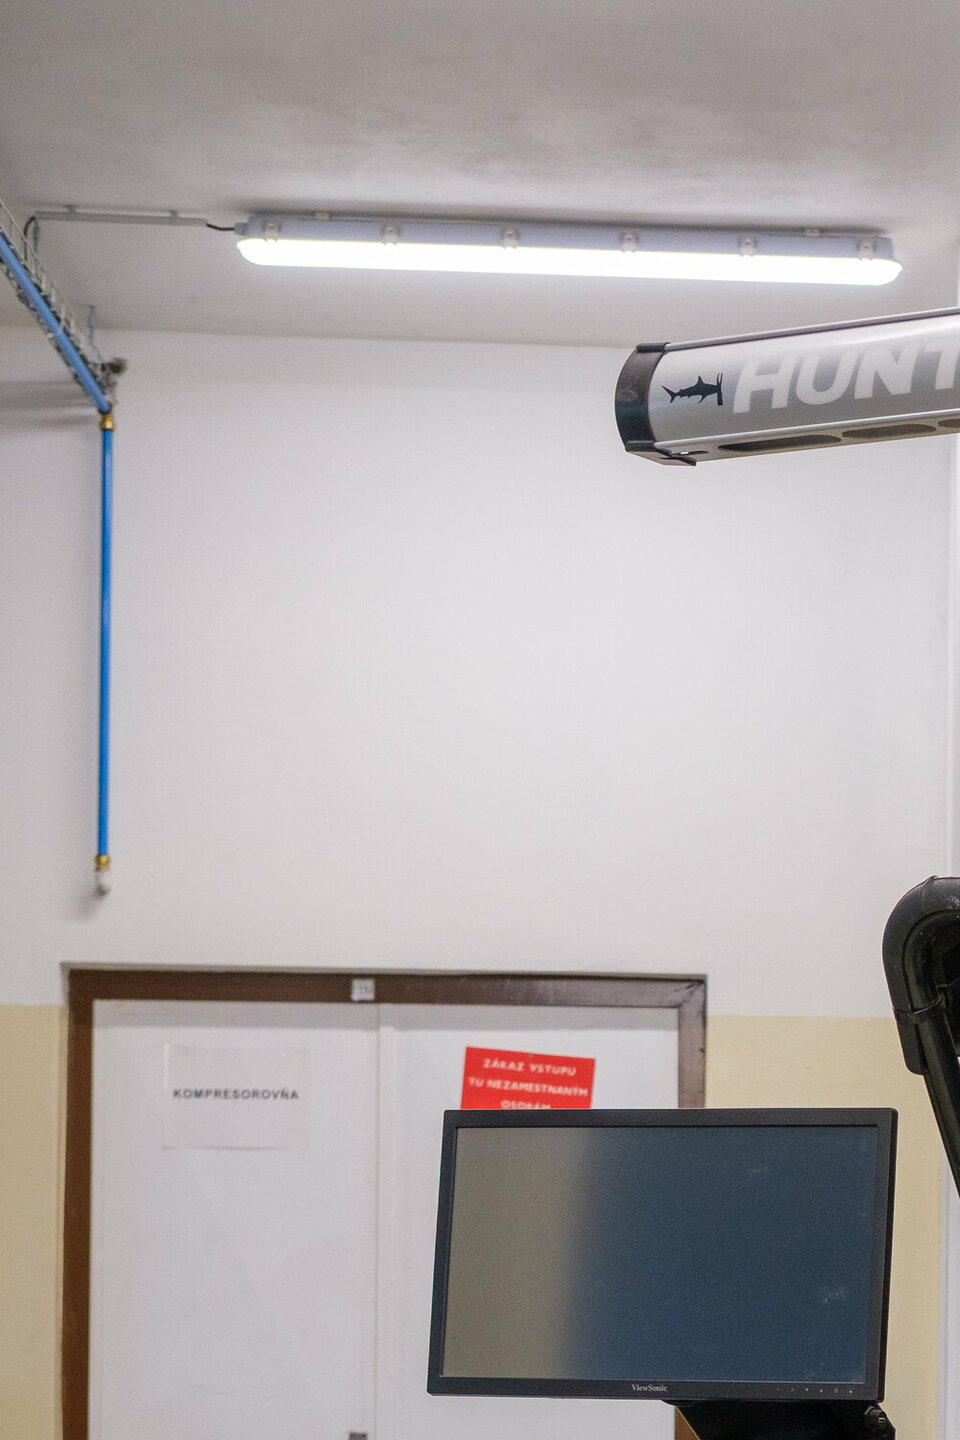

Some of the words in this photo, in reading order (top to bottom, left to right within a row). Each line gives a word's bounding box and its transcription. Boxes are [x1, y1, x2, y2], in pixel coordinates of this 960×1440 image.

[483, 1057, 525, 1072] ZÁKAZ
[529, 1063, 577, 1077] VSTUPU
[173, 1086, 299, 1100] KOMPRESOROVŇA
[631, 1384, 668, 1392] ViewSonic
